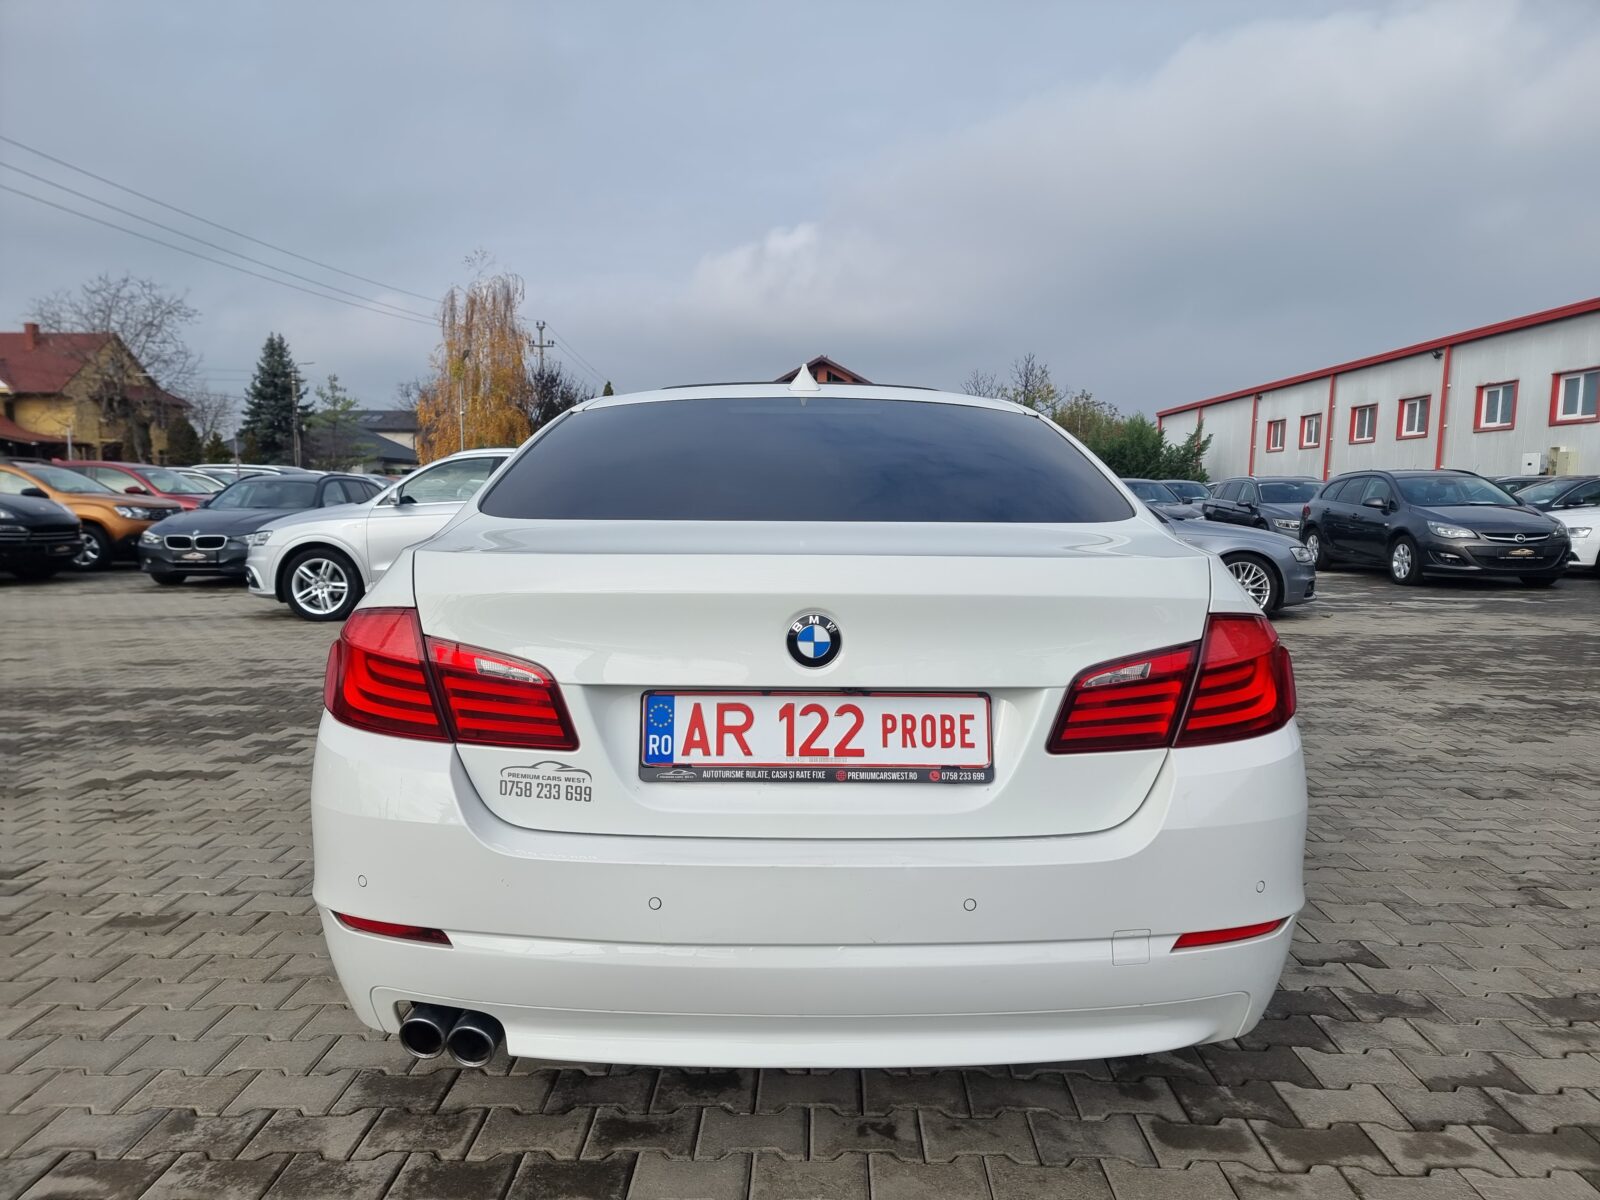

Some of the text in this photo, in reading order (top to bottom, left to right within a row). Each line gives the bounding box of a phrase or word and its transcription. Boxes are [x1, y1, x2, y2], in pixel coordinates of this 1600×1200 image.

[792, 615, 837, 633] BMW
[681, 703, 976, 757] AR 122 PROBE
[648, 734, 672, 755] RO
[507, 772, 540, 780] PREMIUM
[702, 770, 744, 779] AUTOTURISME
[771, 771, 788, 779] CASH
[795, 771, 811, 779] RATE
[812, 771, 826, 779] FIXE
[847, 771, 918, 780] PREMIUMCARSWEST.RO
[941, 771, 985, 780] 0758 233 699
[500, 779, 592, 802] 0758 233 699
